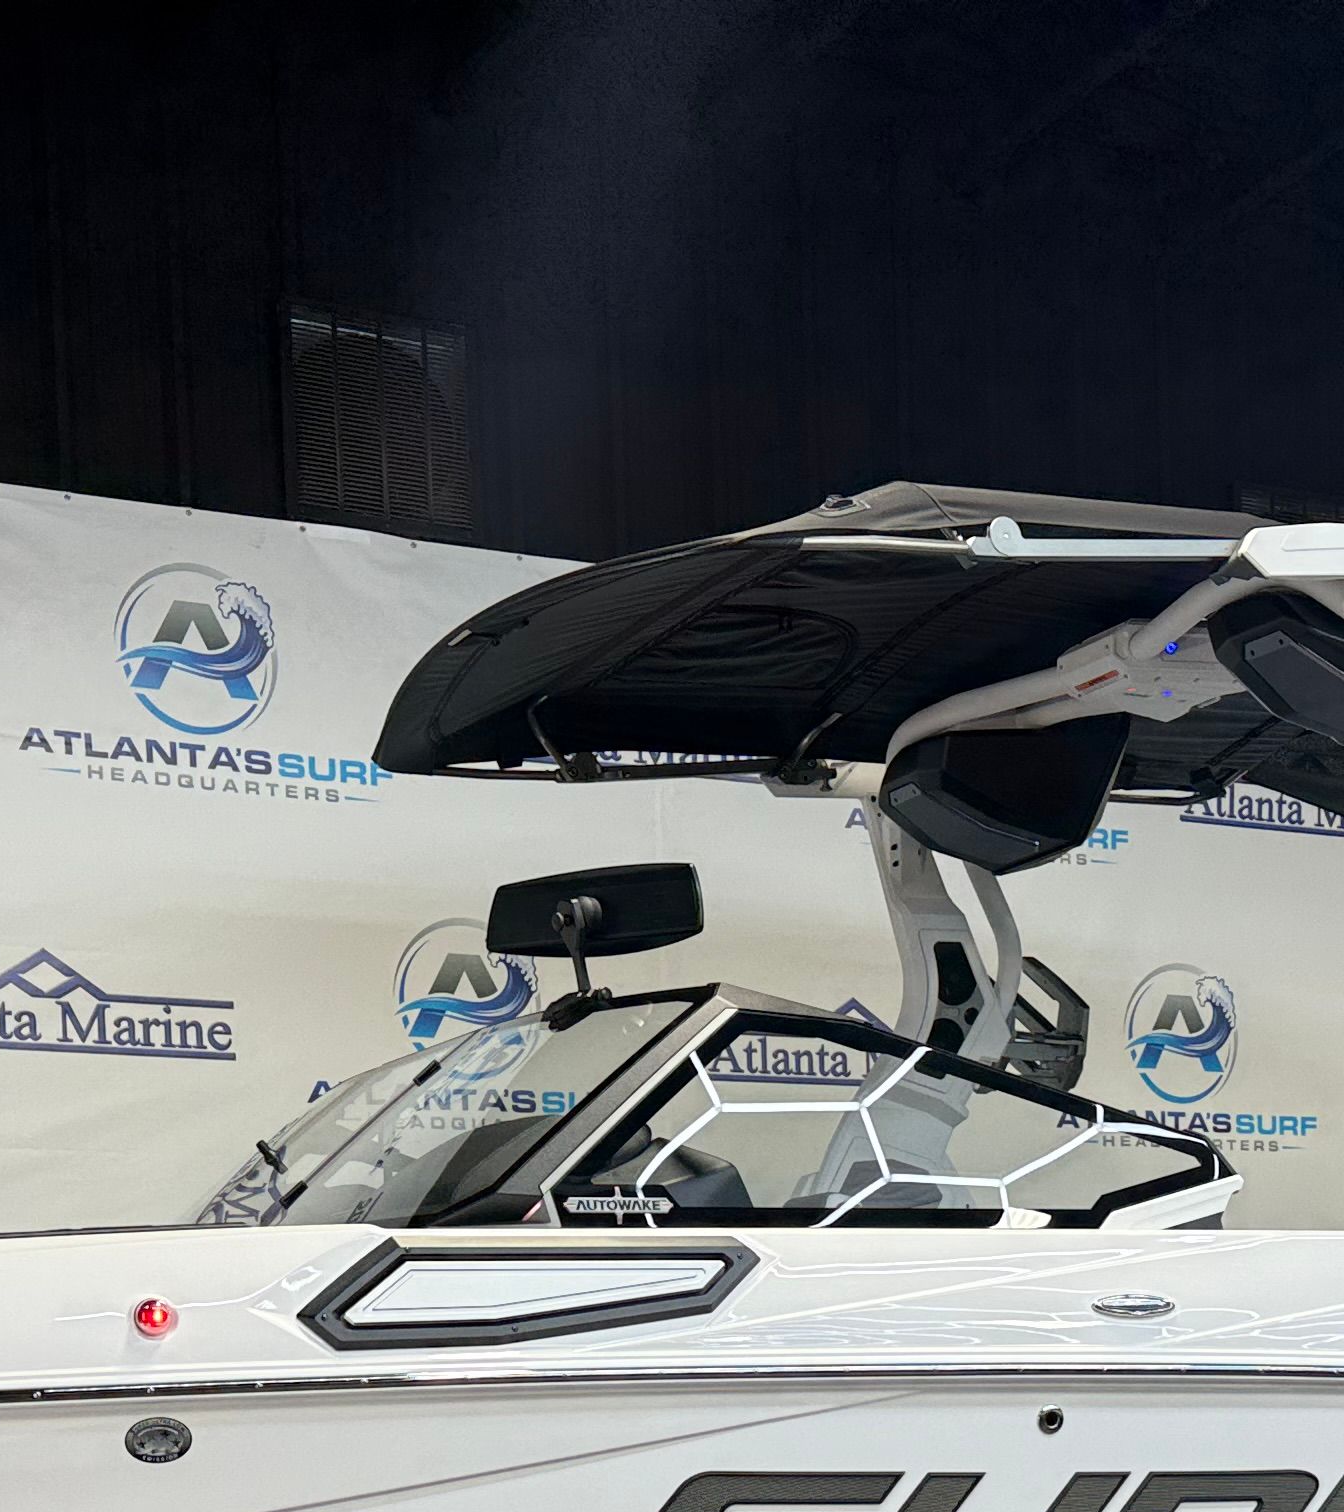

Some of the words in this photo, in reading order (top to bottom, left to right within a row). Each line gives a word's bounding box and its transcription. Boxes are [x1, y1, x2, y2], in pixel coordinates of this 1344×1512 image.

[19, 727, 272, 775] ATLANTA'S
[87, 765, 340, 803] HEADQUARTERS
[56, 1001, 233, 1051] Marine
[1236, 1114, 1317, 1136] SURF
[576, 1199, 661, 1211] AUTOWAKE
